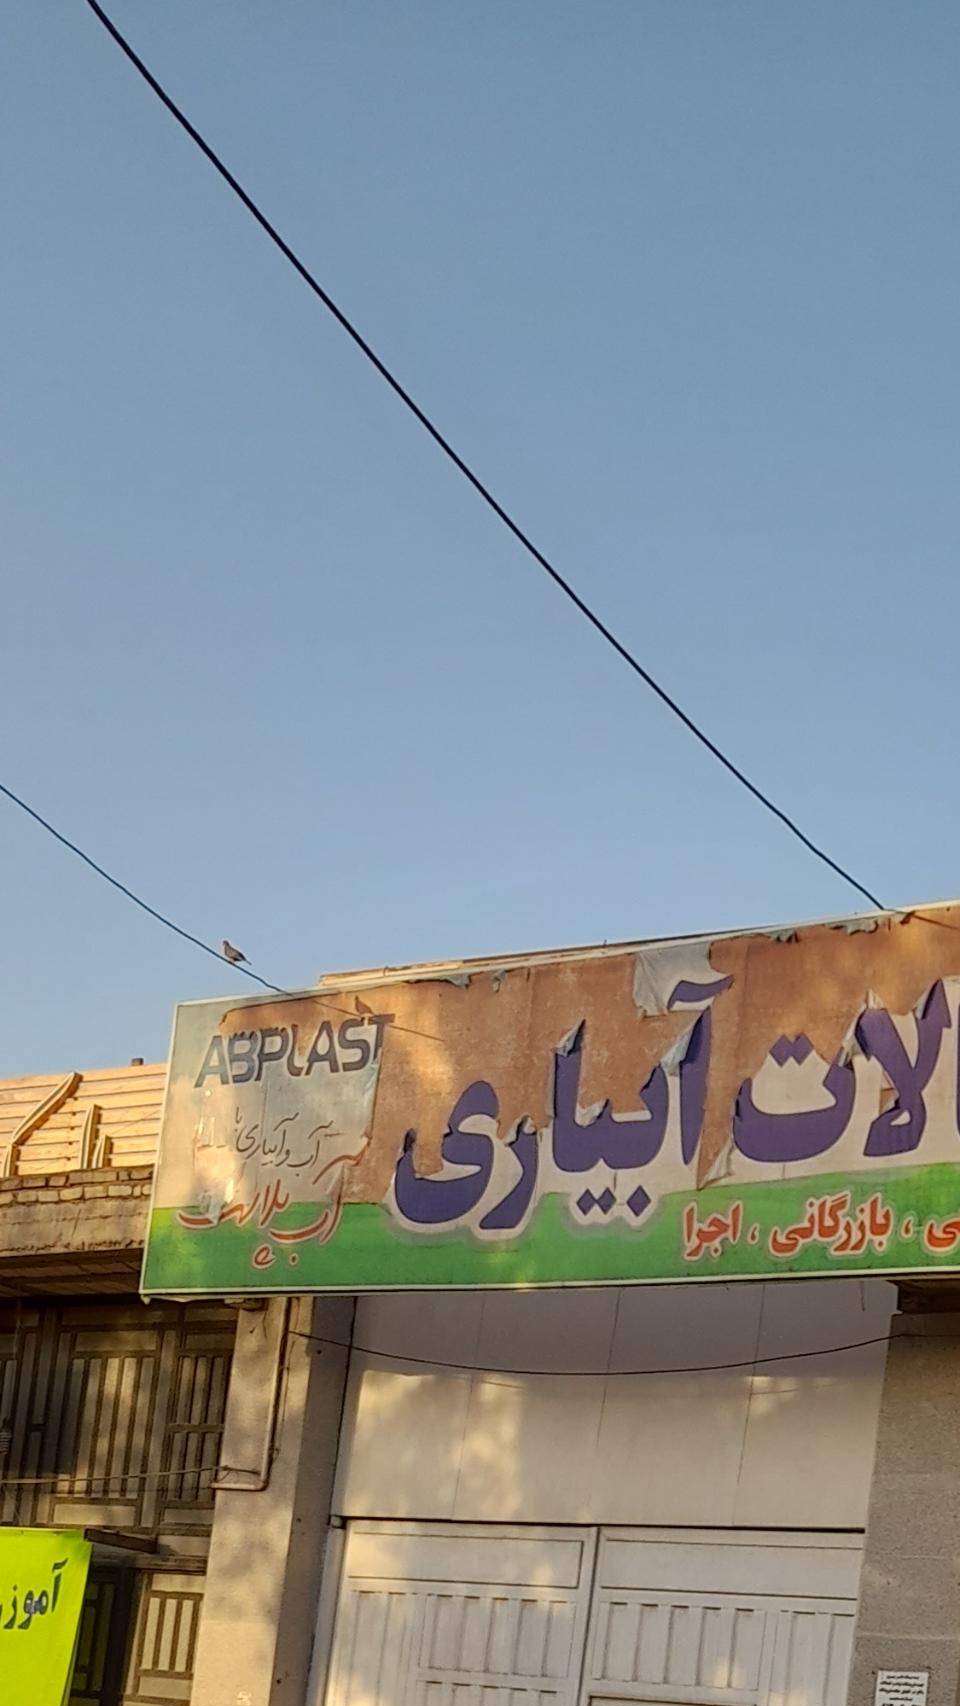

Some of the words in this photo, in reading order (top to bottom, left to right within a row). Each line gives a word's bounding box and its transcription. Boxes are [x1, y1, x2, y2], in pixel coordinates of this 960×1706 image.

[193, 1012, 396, 1089] ABPLAST
[394, 975, 734, 1230] آبیاری
[685, 1203, 741, 1257] اجرا
[0, 1558, 69, 1630] آموز
